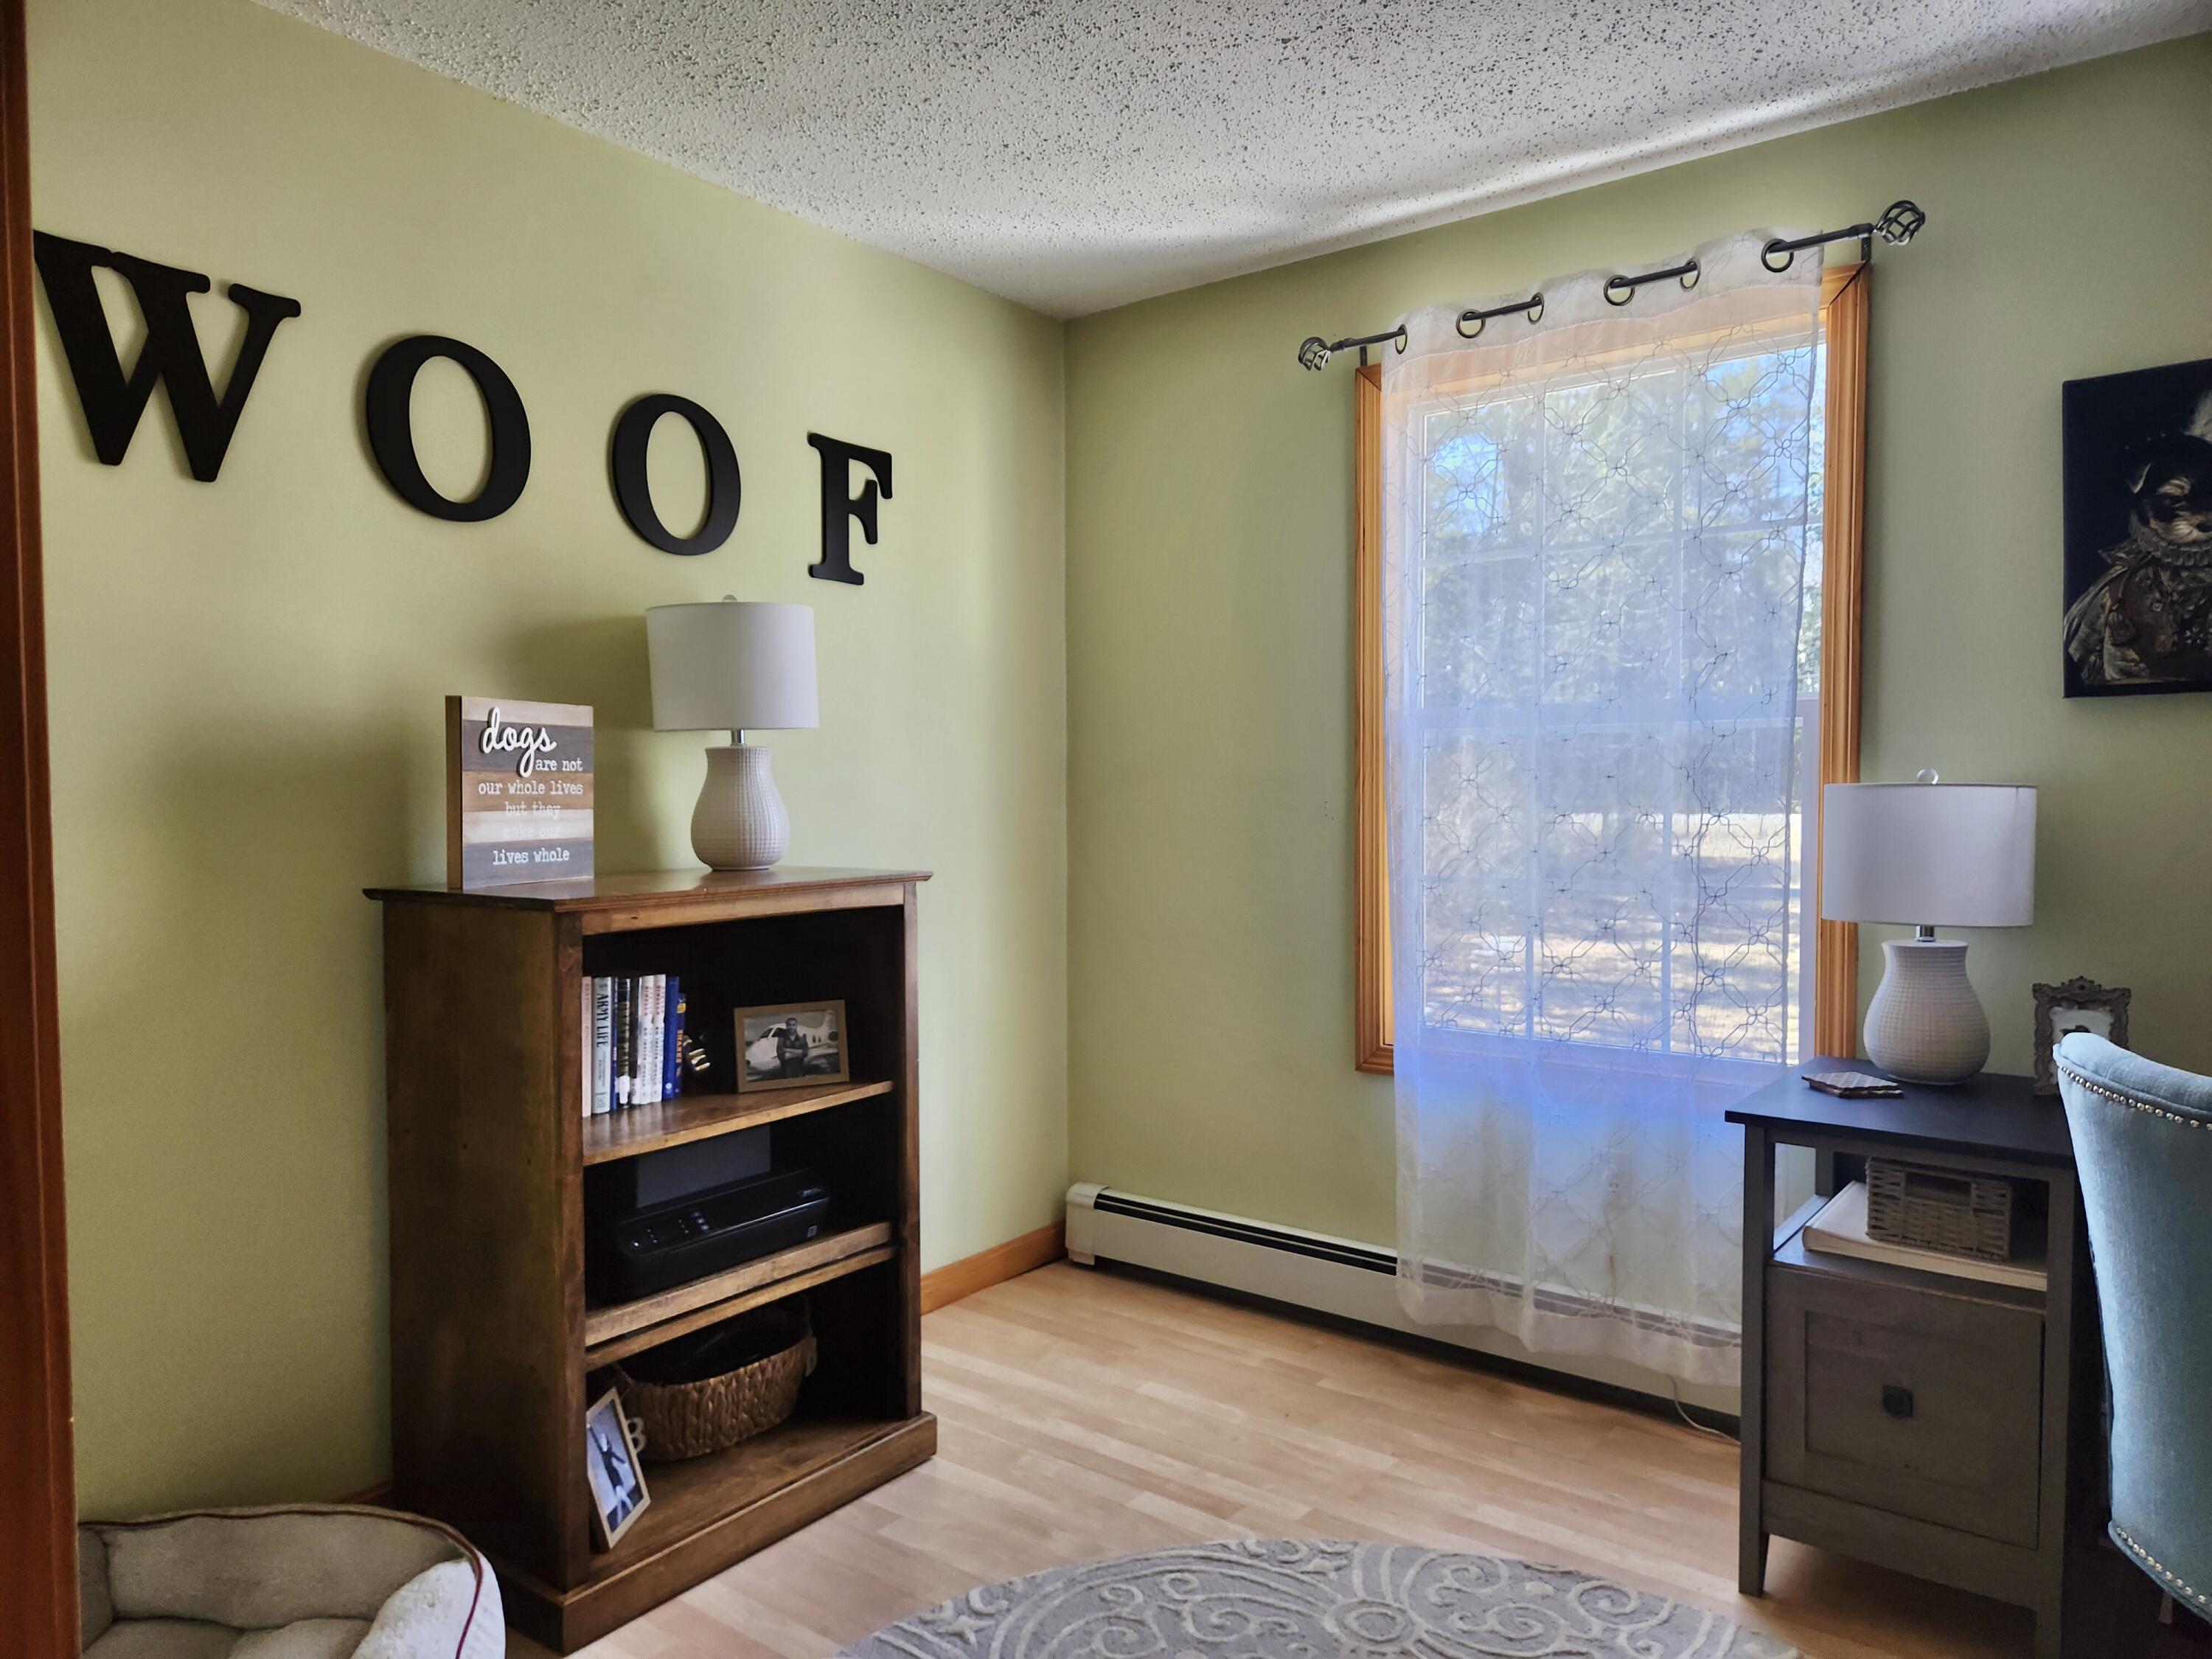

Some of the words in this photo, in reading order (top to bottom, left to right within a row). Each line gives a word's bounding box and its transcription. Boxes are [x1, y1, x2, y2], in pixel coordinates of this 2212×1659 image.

[34, 230, 892, 585] WOOF
[481, 706, 557, 778] dogs
[535, 759, 557, 771] are
[561, 758, 583, 771] not
[478, 782, 503, 795] our
[508, 779, 545, 794] whole
[550, 780, 583, 795] lives
[505, 801, 527, 815] but
[532, 801, 560, 820] they
[493, 849, 529, 865] lives
[533, 847, 570, 863] whole
[597, 993, 608, 1021] ARMY
[597, 1026, 608, 1047] LIFE
